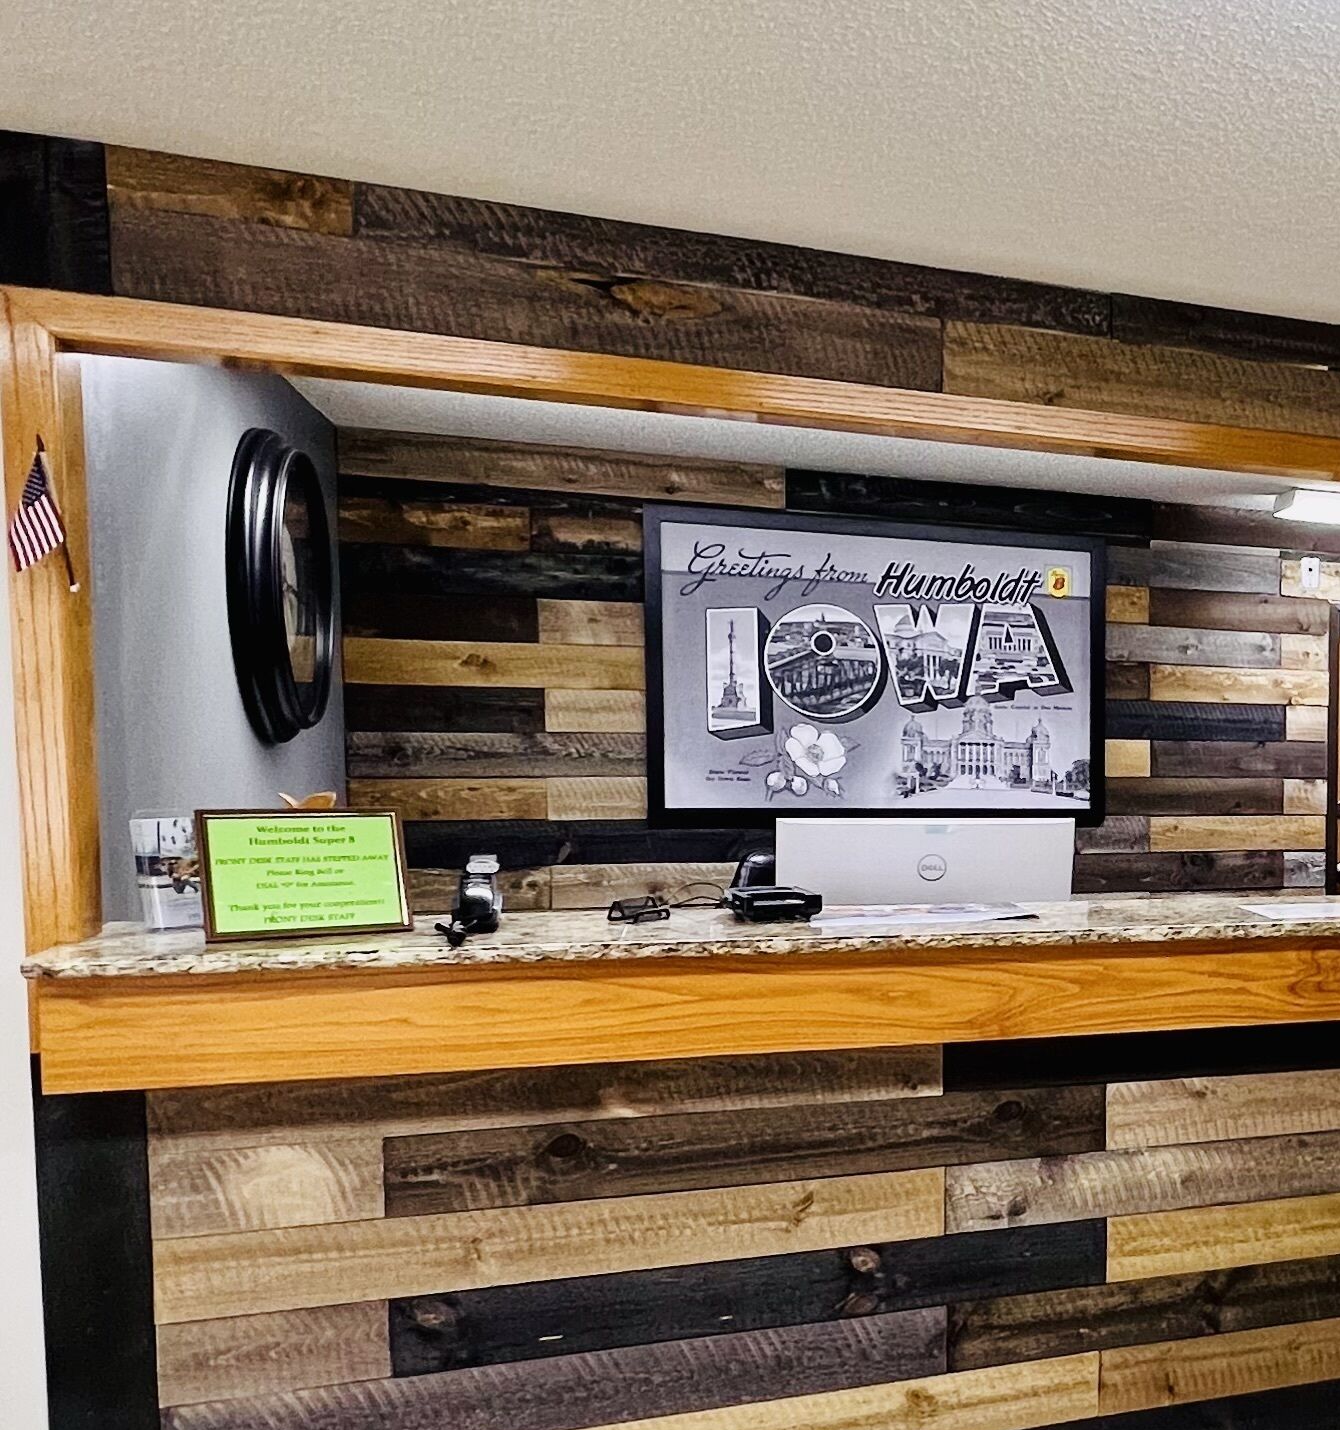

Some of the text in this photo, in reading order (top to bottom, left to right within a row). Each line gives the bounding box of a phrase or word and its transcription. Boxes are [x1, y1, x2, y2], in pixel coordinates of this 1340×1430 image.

[680, 541, 1042, 605] Greetings from Humboldt
[704, 603, 1074, 741] IOWA
[256, 825, 346, 833] Welcome to the
[249, 837, 310, 846] Humboldt
[312, 836, 346, 846] Super
[921, 864, 944, 872] DELL
